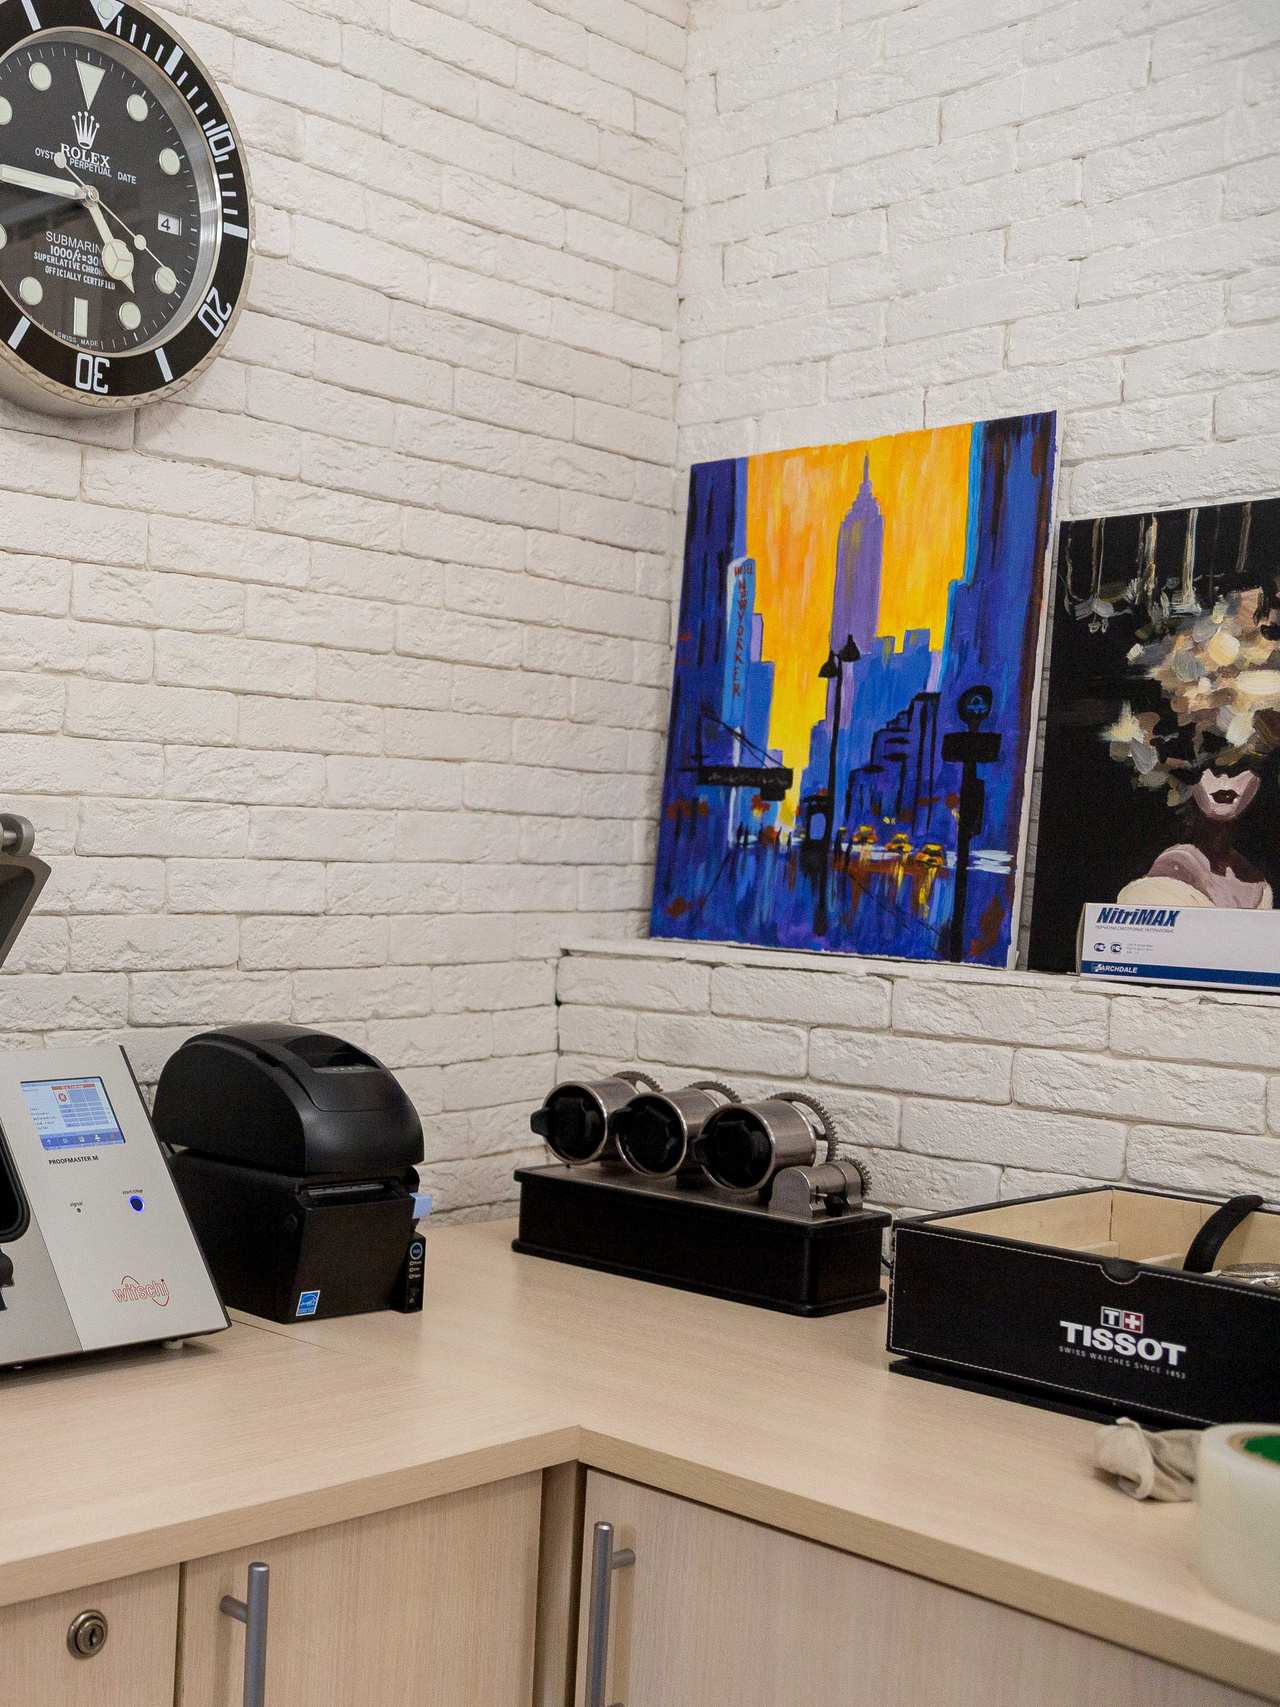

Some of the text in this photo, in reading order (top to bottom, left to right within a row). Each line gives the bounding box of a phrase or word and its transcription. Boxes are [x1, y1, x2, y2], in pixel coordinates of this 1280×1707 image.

[205, 123, 236, 156] 10
[60, 142, 110, 168] ROLEX
[70, 158, 112, 178] PERPETUAL
[117, 171, 137, 185] DATE
[161, 218, 171, 231] 4
[45, 231, 102, 254] SUBMARIN
[34, 251, 81, 271] SUPERLATIVE
[45, 265, 116, 290] OFFICIALLY CERTIFIED
[197, 286, 233, 338] 20
[57, 331, 99, 347] SWISS MADE
[75, 352, 111, 394] 30
[1096, 907, 1181, 927] NitriMAX
[48, 1156, 91, 1165] PROOFMASTER
[112, 1278, 170, 1303] witschi
[1059, 1320, 1187, 1366] TISSOT
[1059, 1345, 1086, 1357] SWISS
[1089, 1352, 1131, 1367] WATCHES
[1134, 1362, 1160, 1374] SINCE
